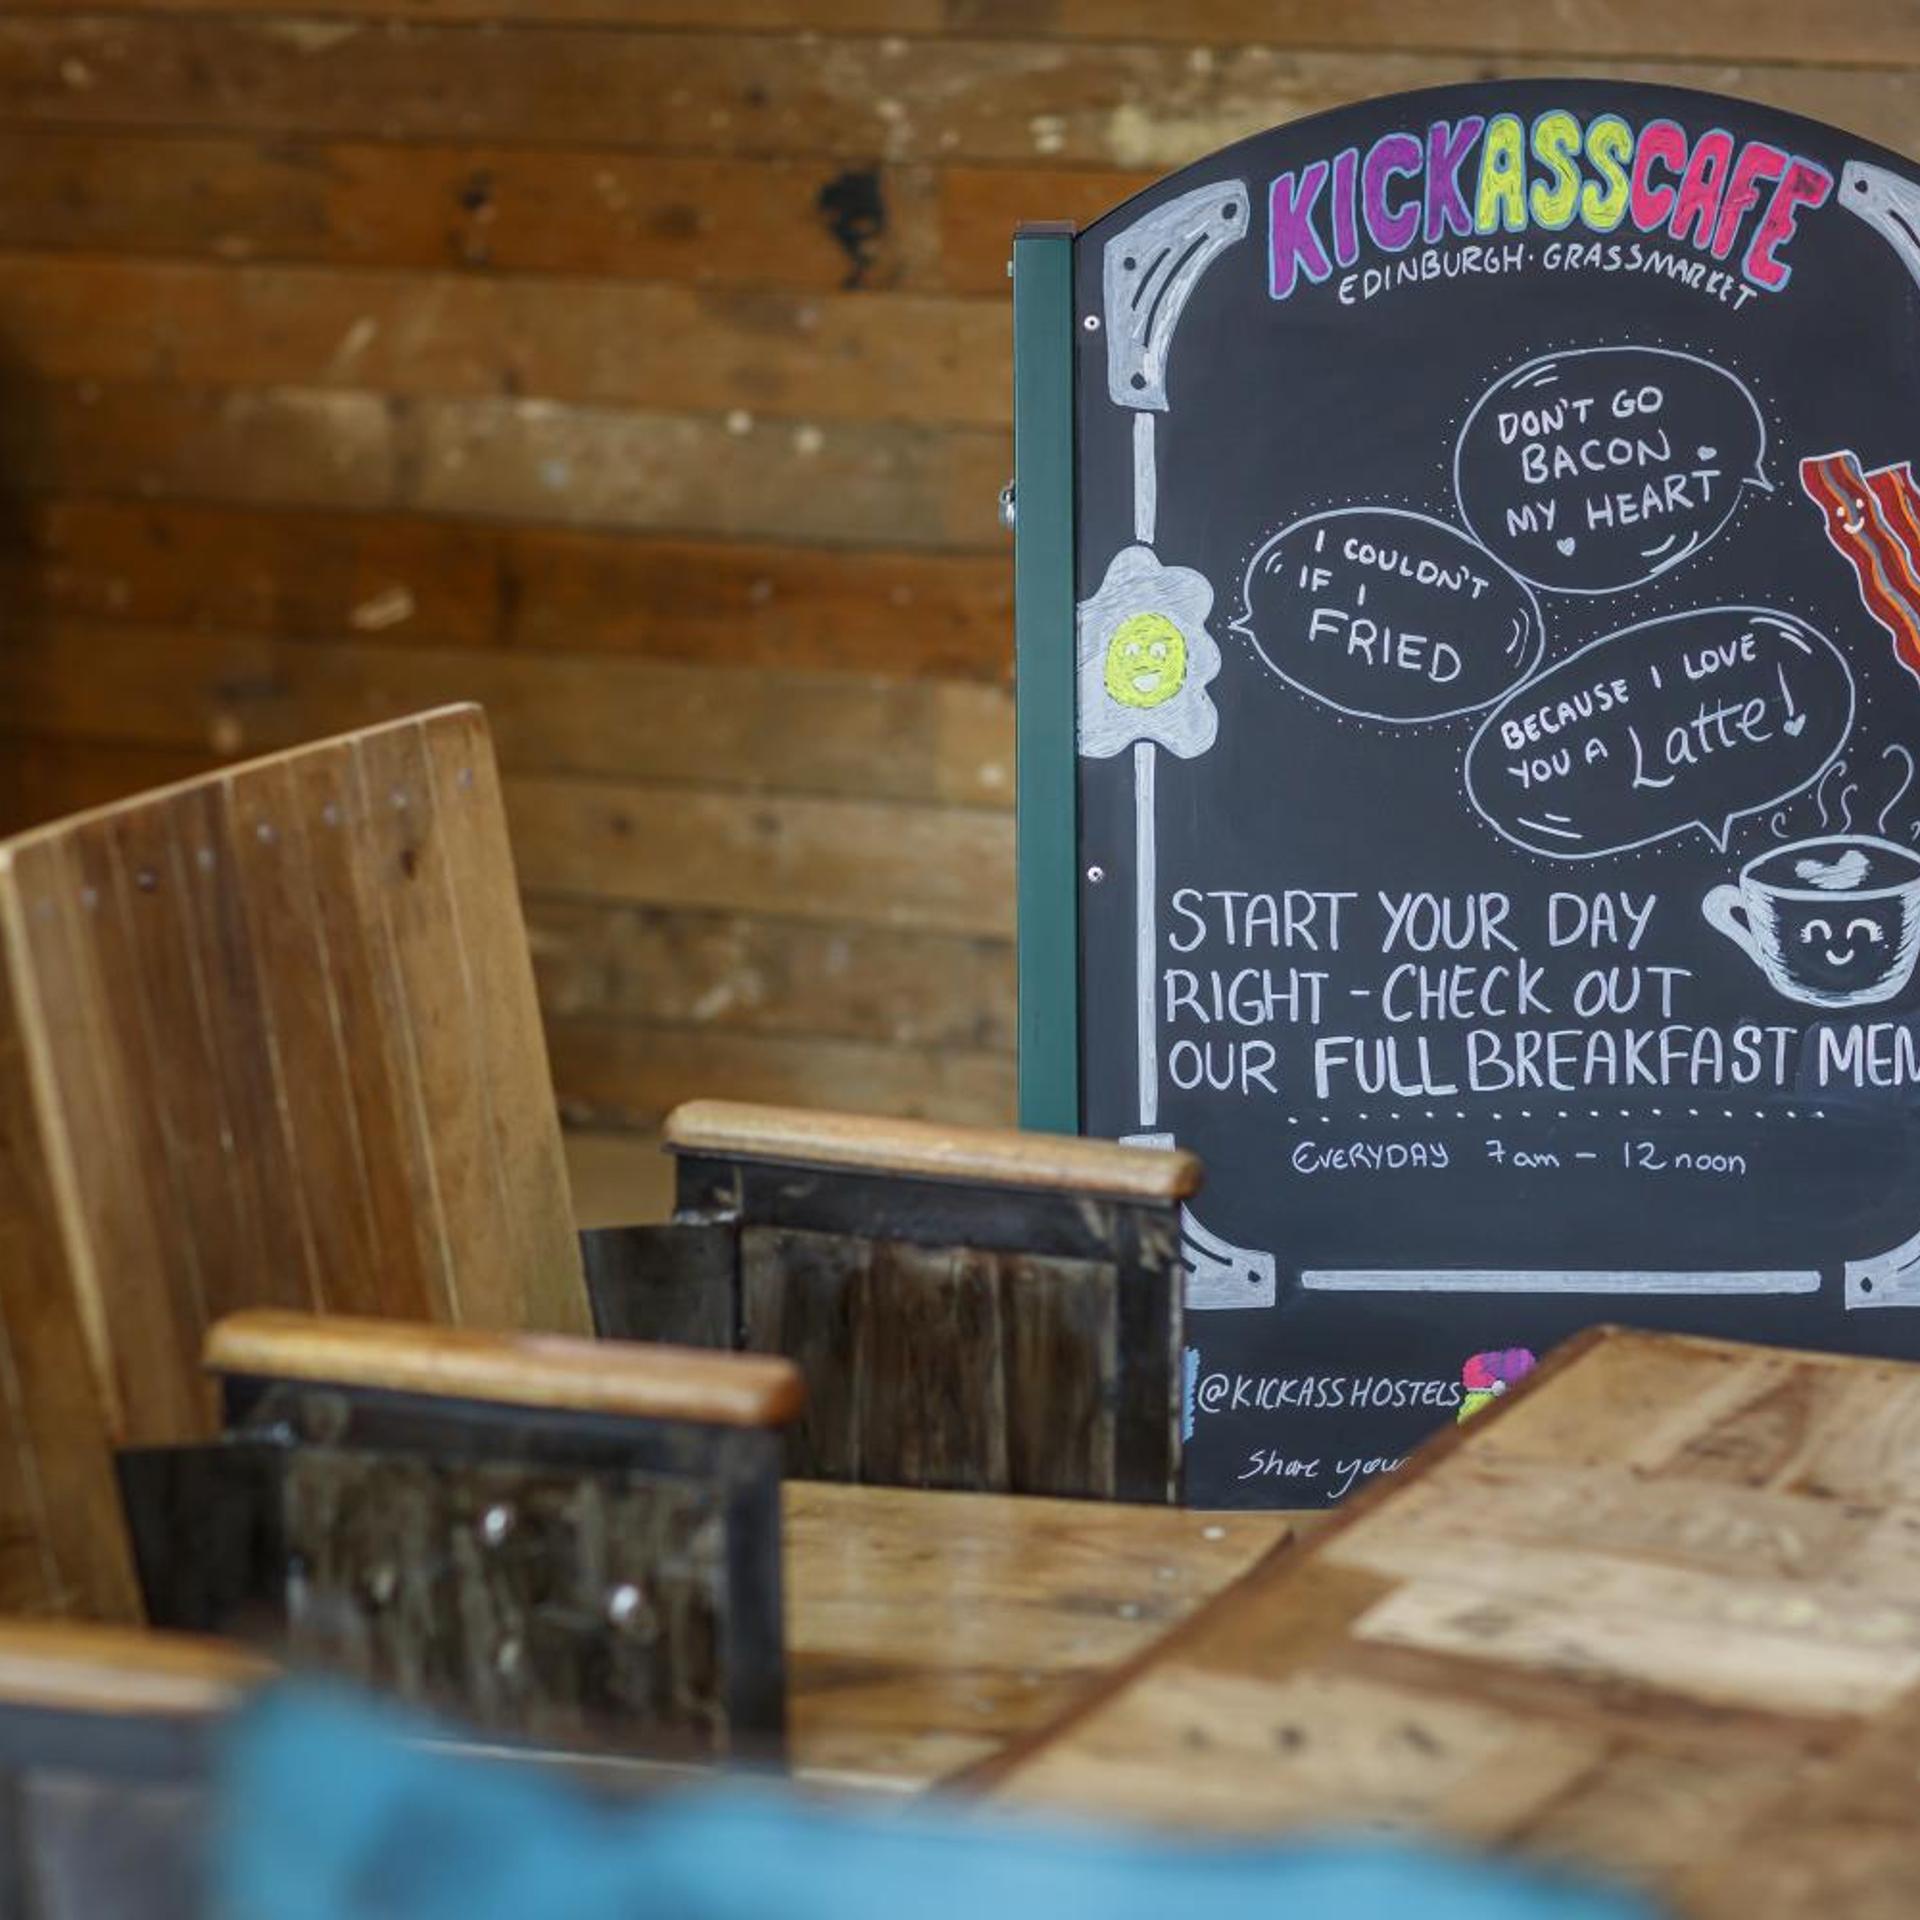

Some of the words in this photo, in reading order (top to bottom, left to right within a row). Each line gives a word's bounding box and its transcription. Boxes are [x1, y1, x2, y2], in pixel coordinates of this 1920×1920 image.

[1543, 243, 1757, 310] GRASSMARKET
[1498, 398, 1593, 445] DON'T
[1612, 385, 1664, 417] GO
[1521, 430, 1671, 485] BACON
[1506, 499, 1557, 537] MY
[1586, 470, 1721, 529] HEART
[1299, 565, 1333, 592] IF
[1357, 585, 1366, 606] I
[1314, 530, 1326, 554] I
[1343, 537, 1489, 598] COULDN'T
[1308, 609, 1462, 683] FRIED
[1501, 679, 1630, 750] BECAUSE
[1650, 666, 1662, 689] I
[1684, 633, 1758, 680] LOVE
[1507, 753, 1572, 790] YOU
[1584, 736, 1609, 762] A
[1168, 888, 1358, 951] START
[1380, 891, 1520, 953] YOUR
[1548, 891, 1658, 950] DAY
[1163, 967, 1330, 1024] RIGHT
[1381, 957, 1554, 1024] CHECK
[1574, 967, 1693, 1018] OUT
[1168, 1039, 1279, 1095] OUR
[1315, 1036, 1458, 1098] FULL
[1466, 1024, 1799, 1093] BREAKFAST
